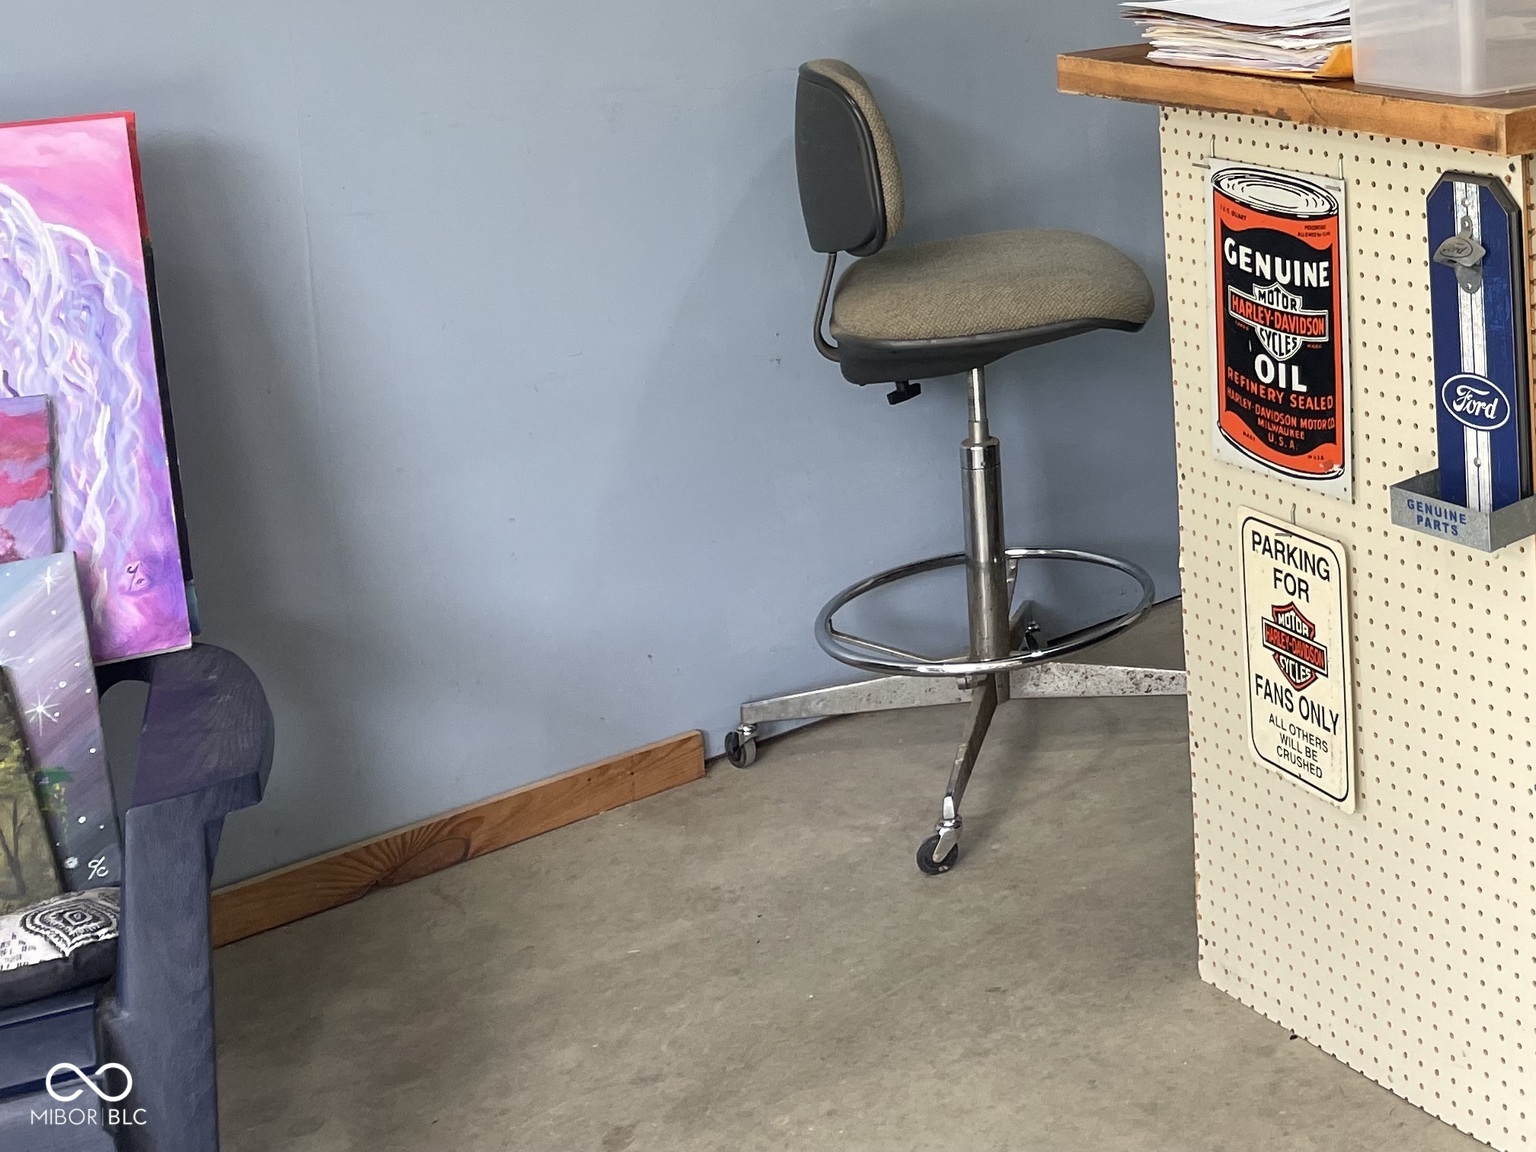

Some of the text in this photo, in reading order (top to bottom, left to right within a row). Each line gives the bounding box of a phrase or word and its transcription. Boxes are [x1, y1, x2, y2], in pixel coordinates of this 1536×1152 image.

[1224, 237, 1329, 287] GENUINE
[1232, 294, 1324, 336] HARLEY-DAVIDSON
[1258, 287, 1297, 311] MOTOR
[1259, 328, 1297, 356] CYCLES
[1228, 367, 1333, 410] REFINERY SEALED
[1255, 354, 1307, 392] OIL
[1453, 385, 1499, 420] Ford
[1258, 418, 1305, 440] MILWAUKEE
[1301, 419, 1327, 429] MOTOR
[1407, 499, 1466, 525] GENUINE
[1417, 515, 1458, 536] PARTS
[1252, 530, 1330, 582] PARKING
[1273, 568, 1309, 602] FOR
[1278, 611, 1309, 637] MOTOR
[1266, 624, 1324, 668] HARLEY-DAVIDSON
[1280, 656, 1311, 683] CYCLES
[1255, 673, 1339, 736] FANS ONLY
[1269, 713, 1328, 753] ALL OTHERS
[1280, 733, 1318, 763] WILL BE
[1276, 745, 1323, 779] CRUSHED
